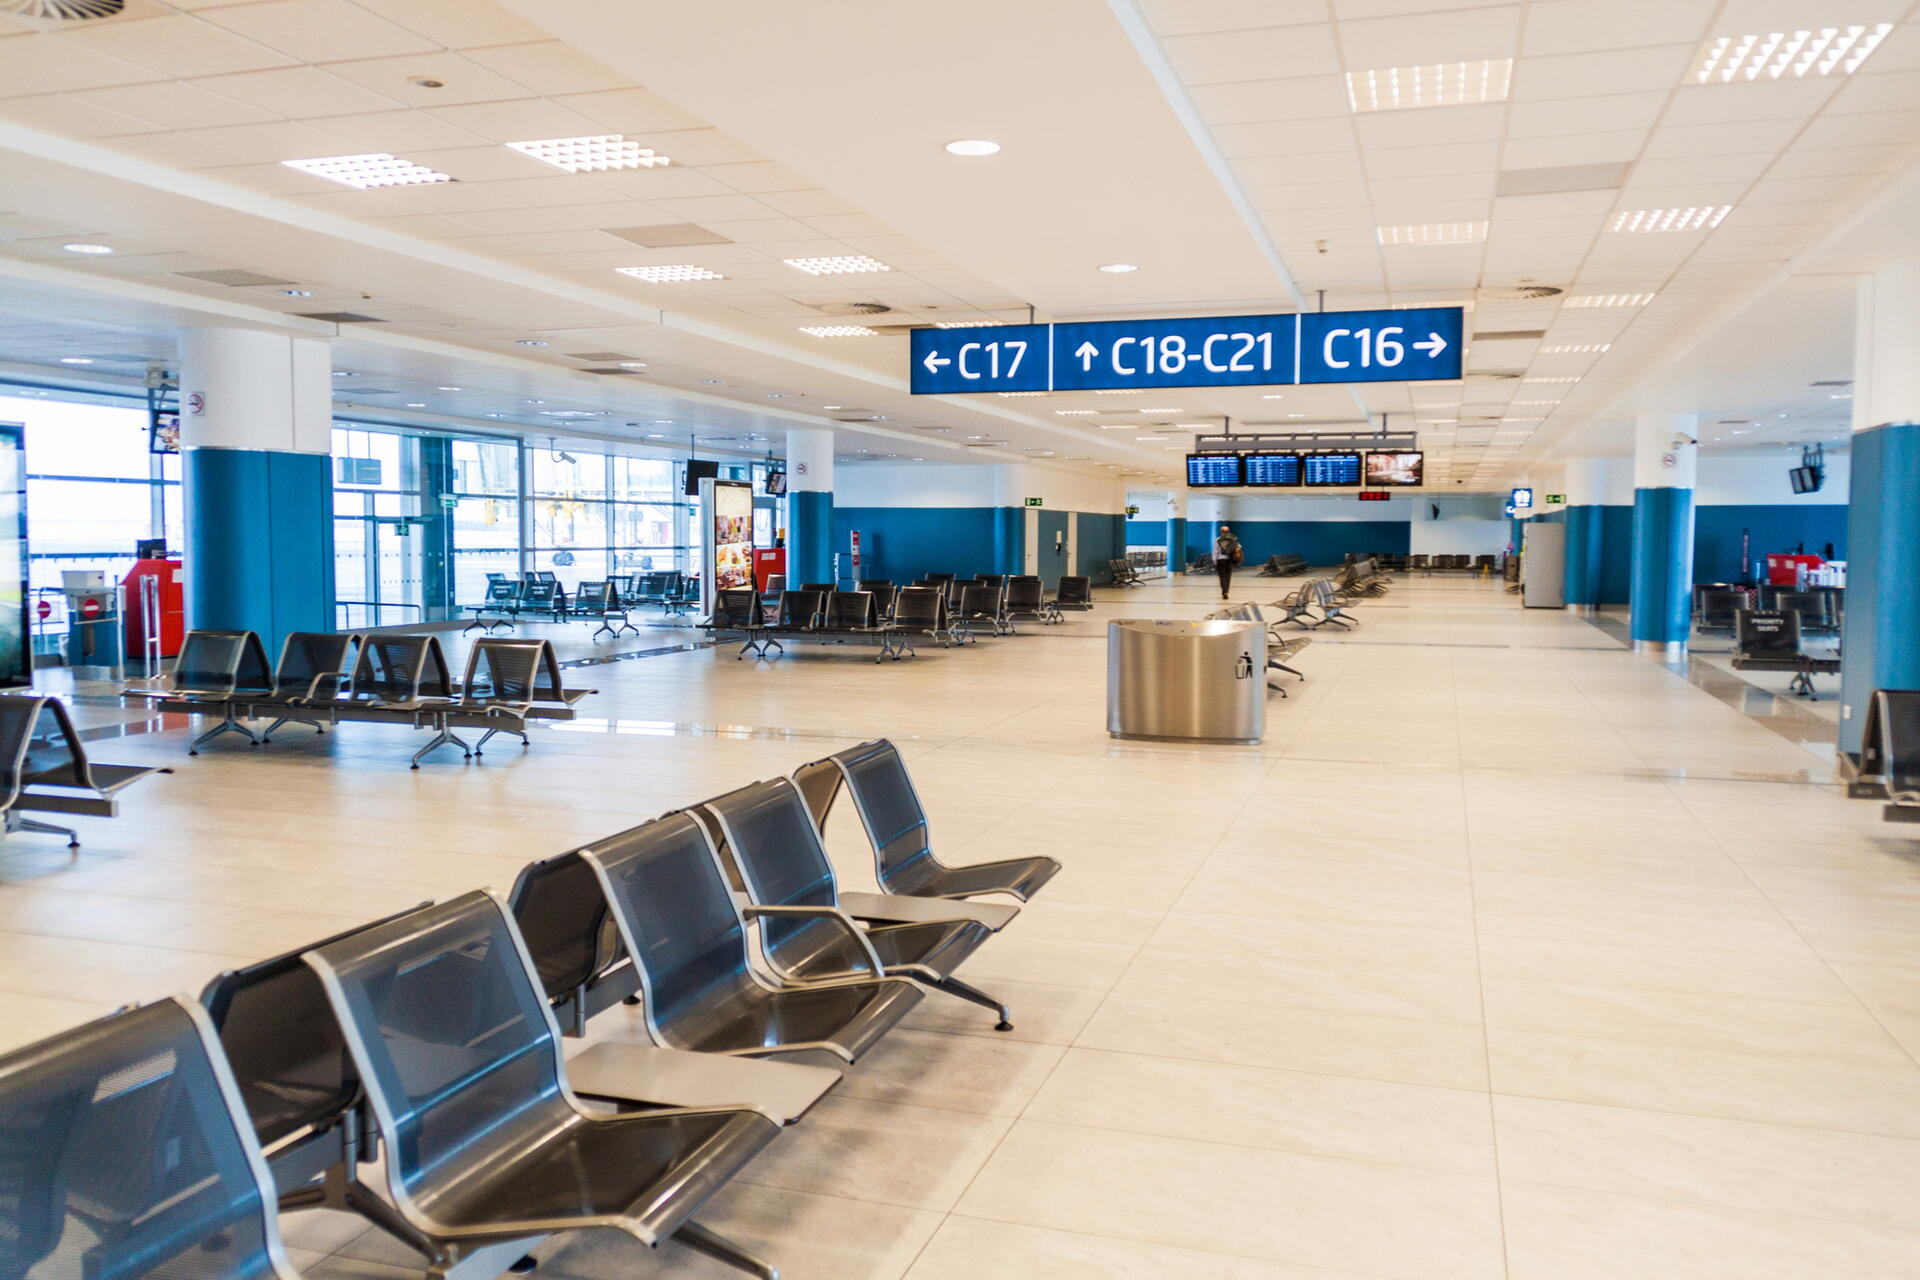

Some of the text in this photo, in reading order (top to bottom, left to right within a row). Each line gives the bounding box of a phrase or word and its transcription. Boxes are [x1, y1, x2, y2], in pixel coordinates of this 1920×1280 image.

[958, 340, 1028, 380] C17
[1111, 331, 1273, 376] C18-C21
[1323, 326, 1405, 369] C16
